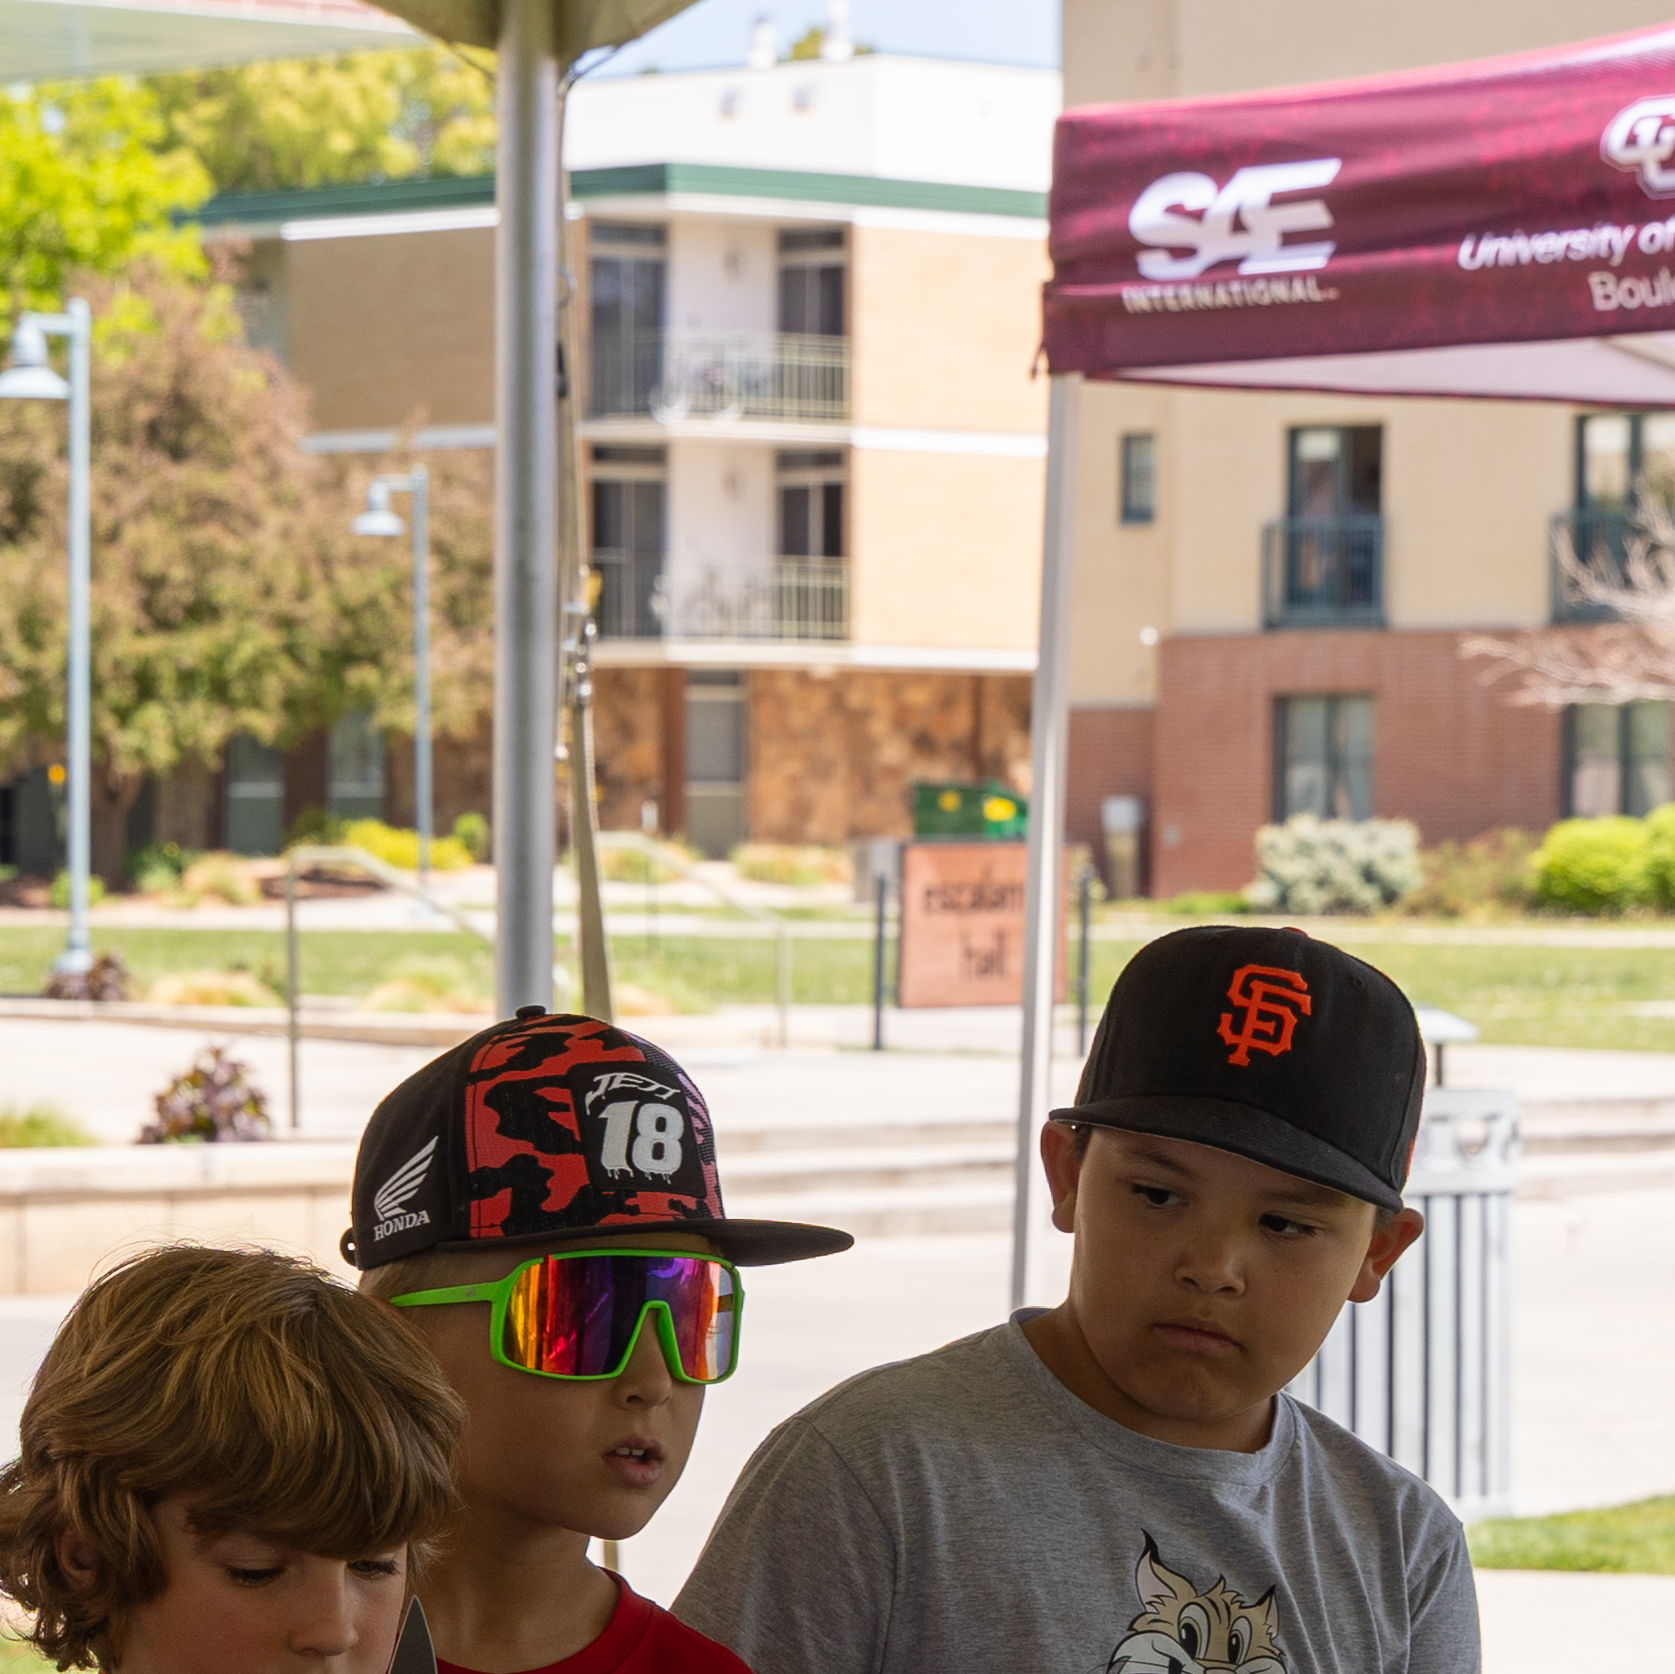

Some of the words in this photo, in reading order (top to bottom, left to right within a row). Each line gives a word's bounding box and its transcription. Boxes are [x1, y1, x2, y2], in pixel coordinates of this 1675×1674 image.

[1128, 157, 1343, 282] SAE
[1457, 219, 1629, 273] University
[1639, 217, 1675, 252] of
[1216, 963, 1312, 1067] SF
[598, 1100, 685, 1185] 18
[373, 1209, 431, 1242] HONDA
